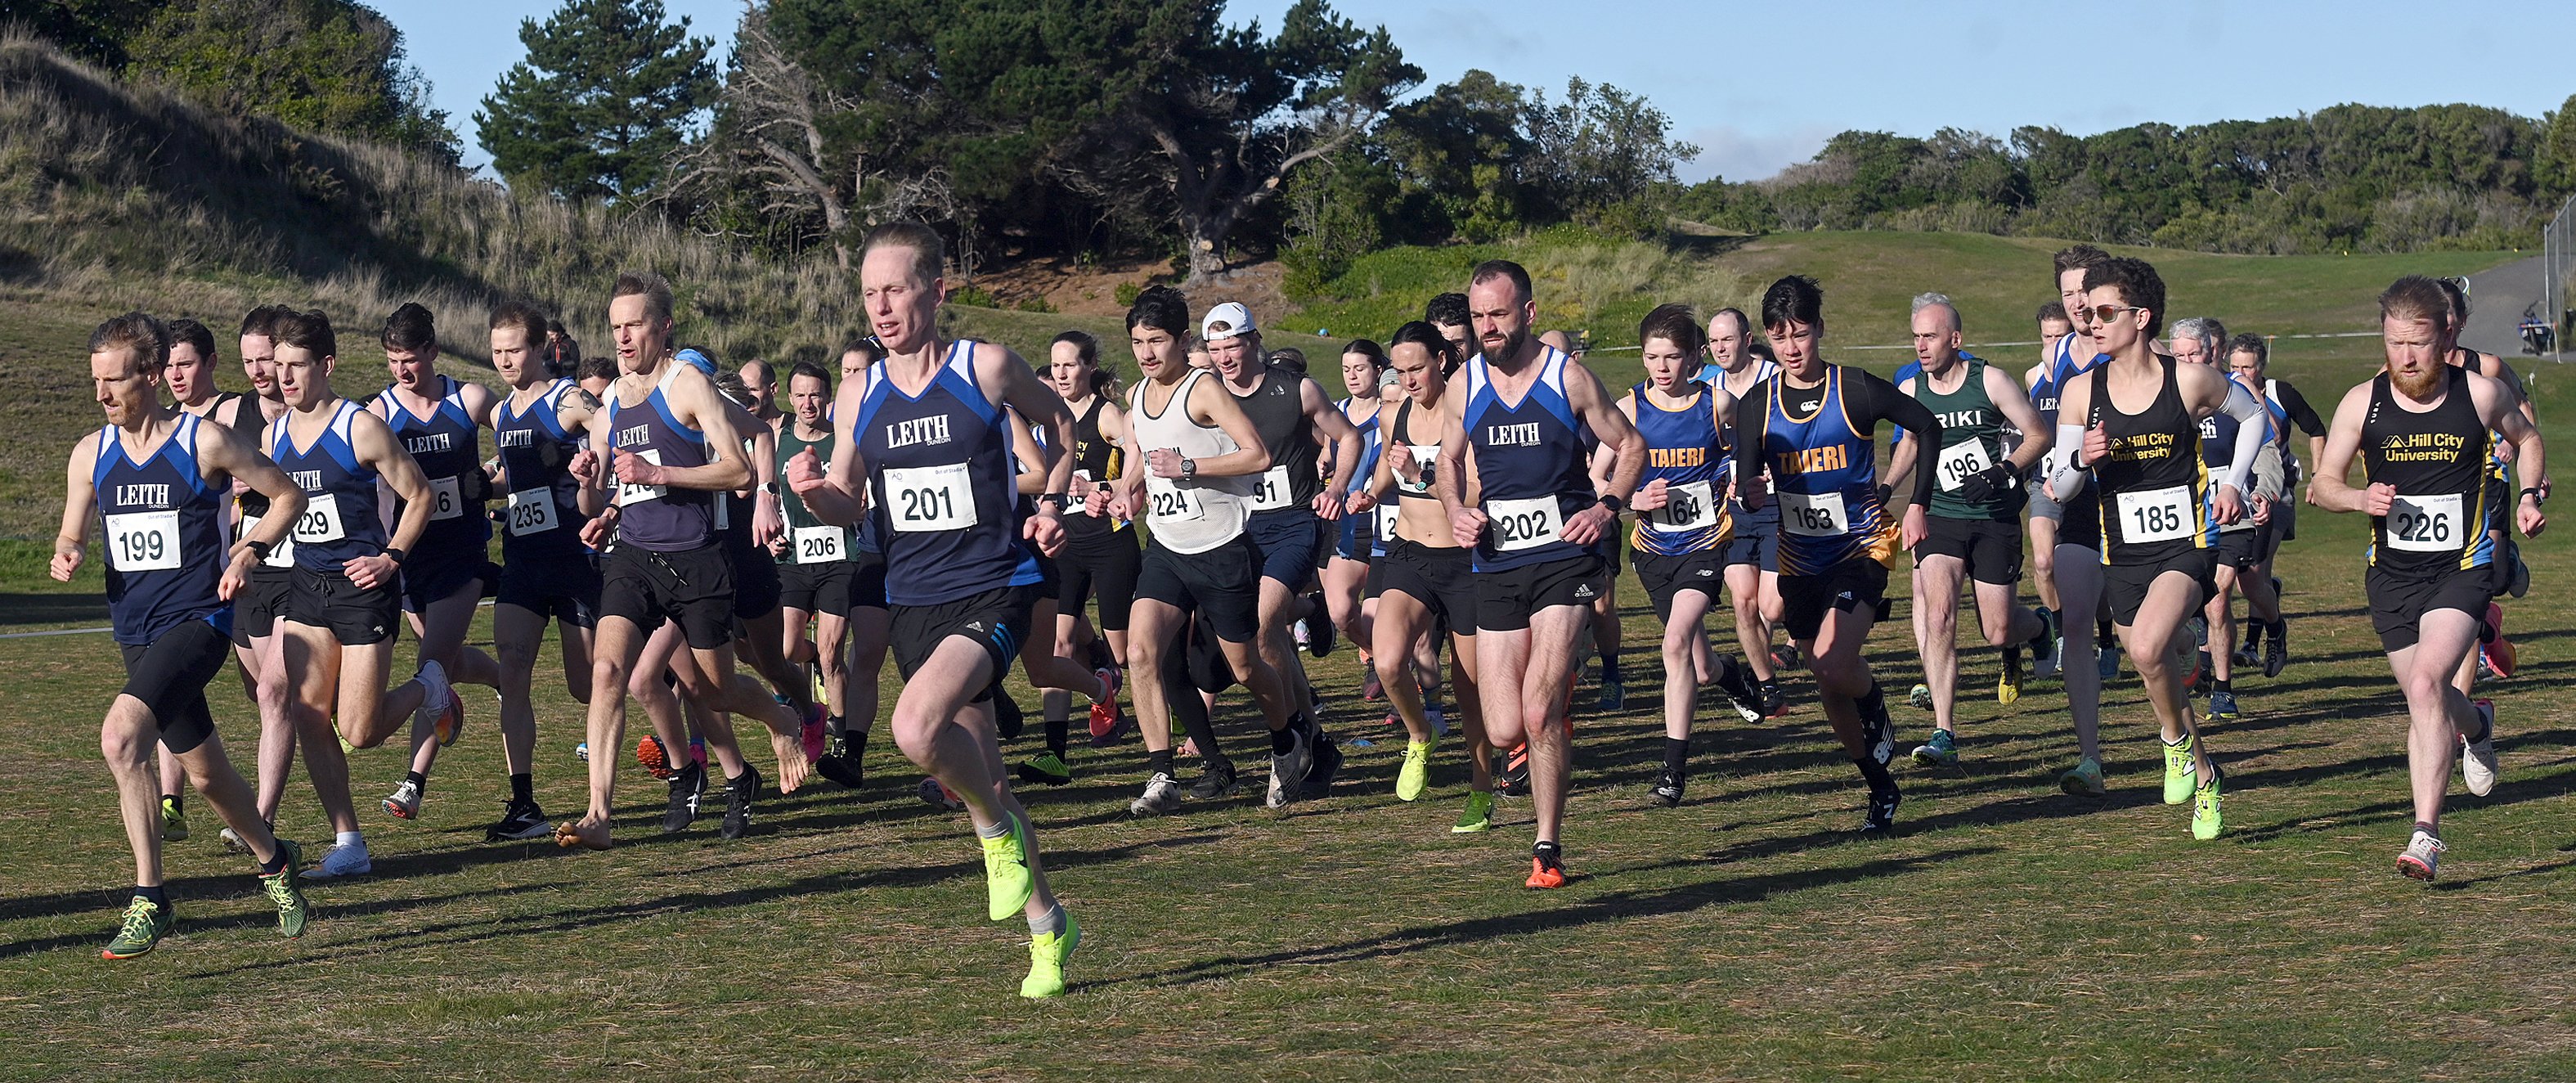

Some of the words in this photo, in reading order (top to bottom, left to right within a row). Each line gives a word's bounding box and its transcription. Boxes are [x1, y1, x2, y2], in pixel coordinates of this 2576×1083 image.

[408, 432, 451, 454] LEITH
[500, 429, 532, 448] LEITH
[616, 424, 650, 448] LEITH
[886, 414, 949, 449] LEITH
[927, 437, 951, 447] DUNEDIN
[1488, 422, 1540, 446] LEITH
[2127, 434, 2147, 447] Hill
[2148, 433, 2174, 447] City
[2408, 434, 2431, 447] Hill
[2434, 433, 2465, 449] City
[1649, 447, 1705, 468] TAIERI
[1777, 444, 1847, 474] TAIERI
[2111, 447, 2171, 462] University
[2385, 448, 2460, 463] University
[1944, 453, 1980, 484] 196
[116, 484, 170, 506] LEITH
[901, 486, 954, 521] 201
[1154, 490, 1187, 517] 224
[298, 511, 330, 535] 229
[514, 501, 545, 529] 235
[1665, 497, 1701, 525] 164
[1793, 506, 1833, 530] 163
[2134, 504, 2179, 534] 185
[1501, 510, 1551, 542] 202
[2398, 513, 2449, 542] 226
[119, 530, 164, 562] 199
[803, 537, 835, 557] 206
